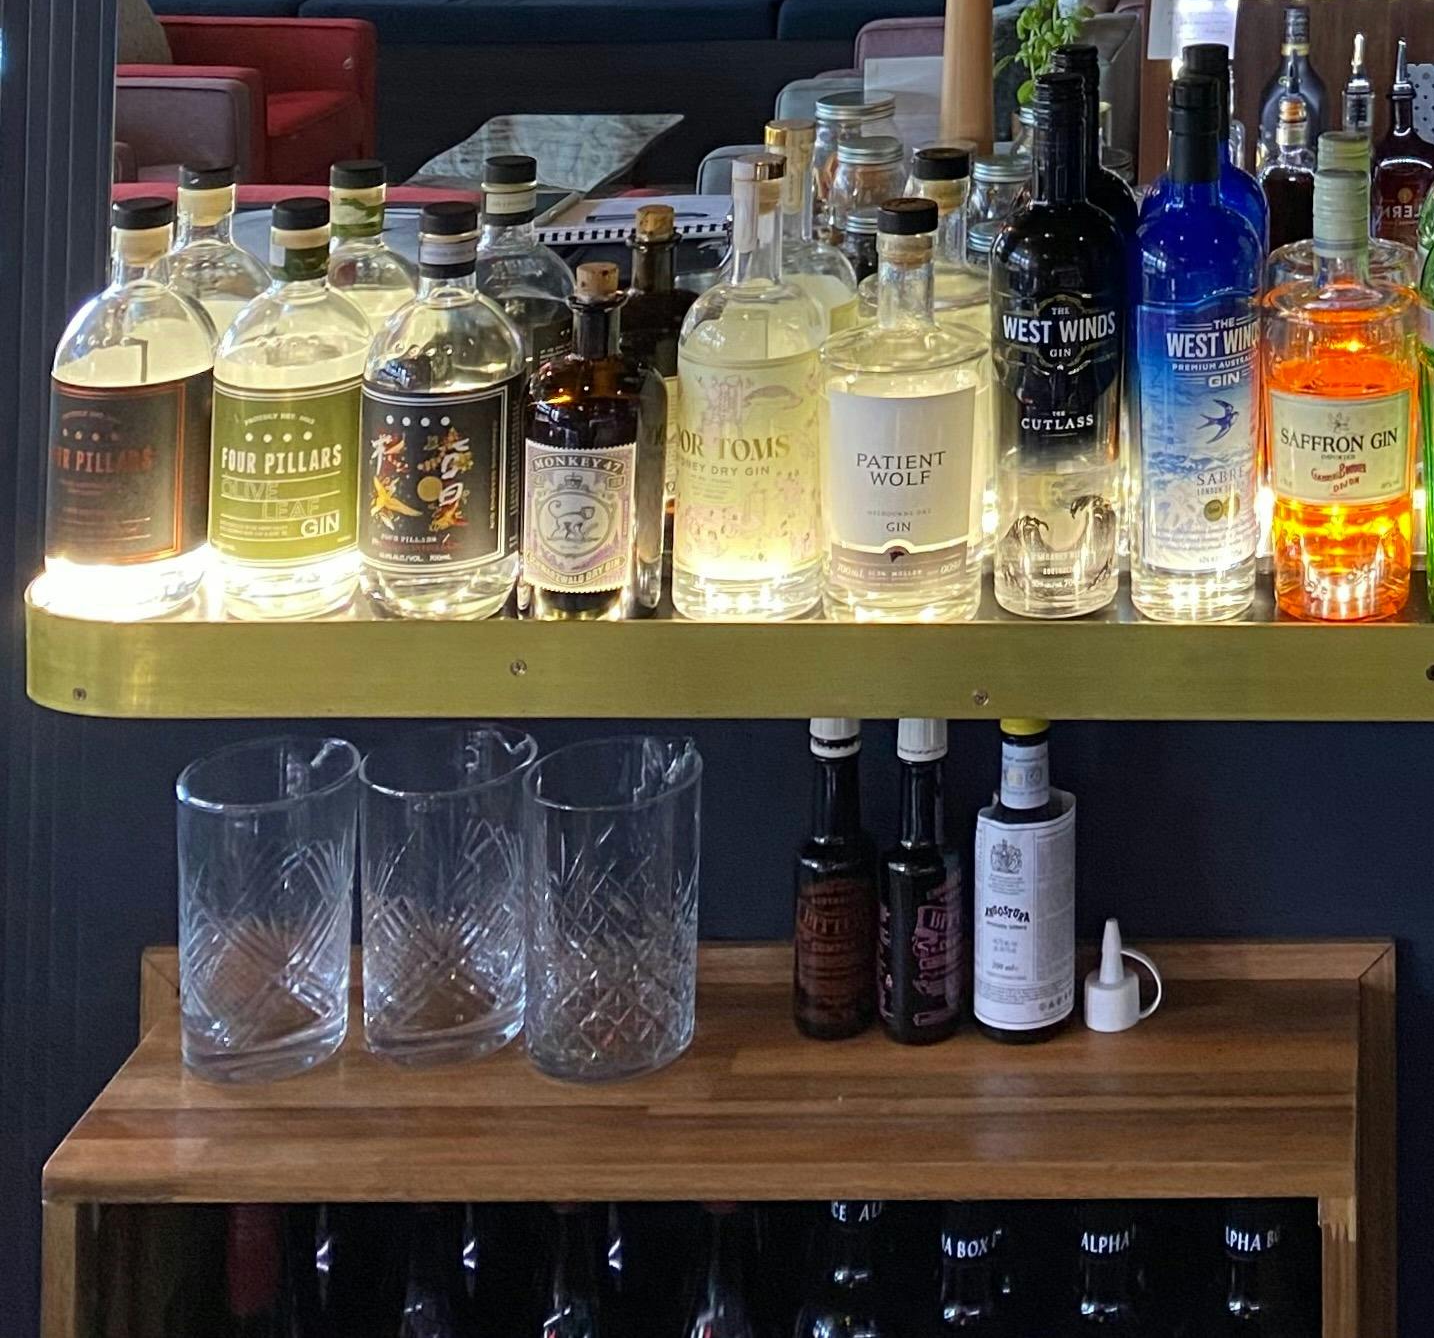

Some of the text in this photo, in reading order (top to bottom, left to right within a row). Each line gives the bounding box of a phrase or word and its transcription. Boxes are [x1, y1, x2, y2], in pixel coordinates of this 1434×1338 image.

[1051, 306, 1070, 315] THE
[1002, 311, 1116, 343] WEST WINDS
[1212, 317, 1235, 328] THE
[1049, 348, 1071, 358] GIN
[1166, 332, 1219, 358] WEST
[1172, 362, 1216, 371] PREMIUM
[1207, 372, 1240, 388] GIN
[1021, 414, 1094, 431] CUTLASS
[716, 435, 792, 463] TOMS
[1281, 428, 1398, 453] SAFFRON GIN
[75, 448, 157, 473] PILLARS
[221, 444, 342, 474] FOUR PILLARS
[534, 456, 622, 473] MONKEY 47
[856, 450, 946, 469] PATIENT
[711, 465, 770, 476] DRY GIN
[870, 470, 931, 487] WOLF
[1196, 467, 1246, 486] SABRE
[221, 480, 279, 501] OLIVE
[1197, 487, 1223, 496] LONDON
[301, 513, 340, 537] GIN
[886, 521, 911, 533] GIN
[585, 557, 620, 583] DRY GIN
[984, 905, 1031, 923] ANGOSTURA
[955, 1236, 989, 1258] BOX
[1080, 1228, 1130, 1254] ALPHA
